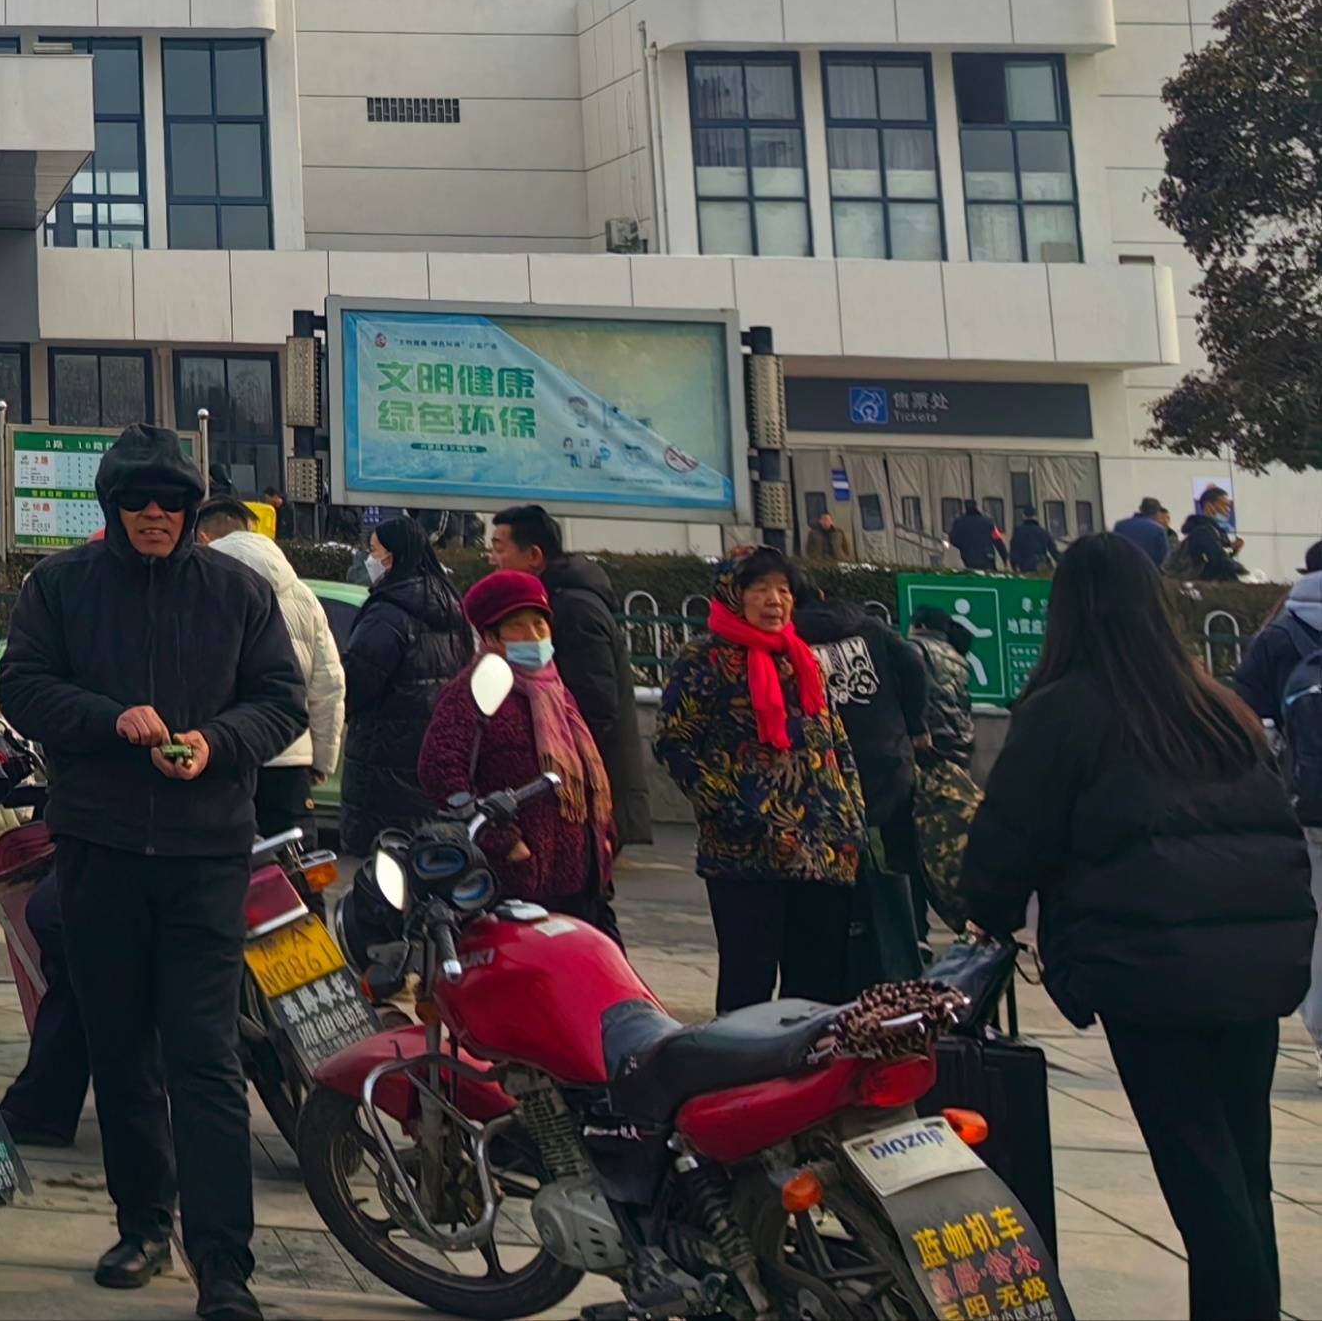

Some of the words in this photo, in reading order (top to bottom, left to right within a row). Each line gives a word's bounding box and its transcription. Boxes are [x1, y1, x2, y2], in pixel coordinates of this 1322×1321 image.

[377, 362, 535, 398] 文明健康
[378, 400, 536, 438] 绿色环保
[893, 392, 949, 410] 售票处
[912, 1205, 1025, 1270] 蓝咖机车
[996, 1276, 1051, 1310] 无极
